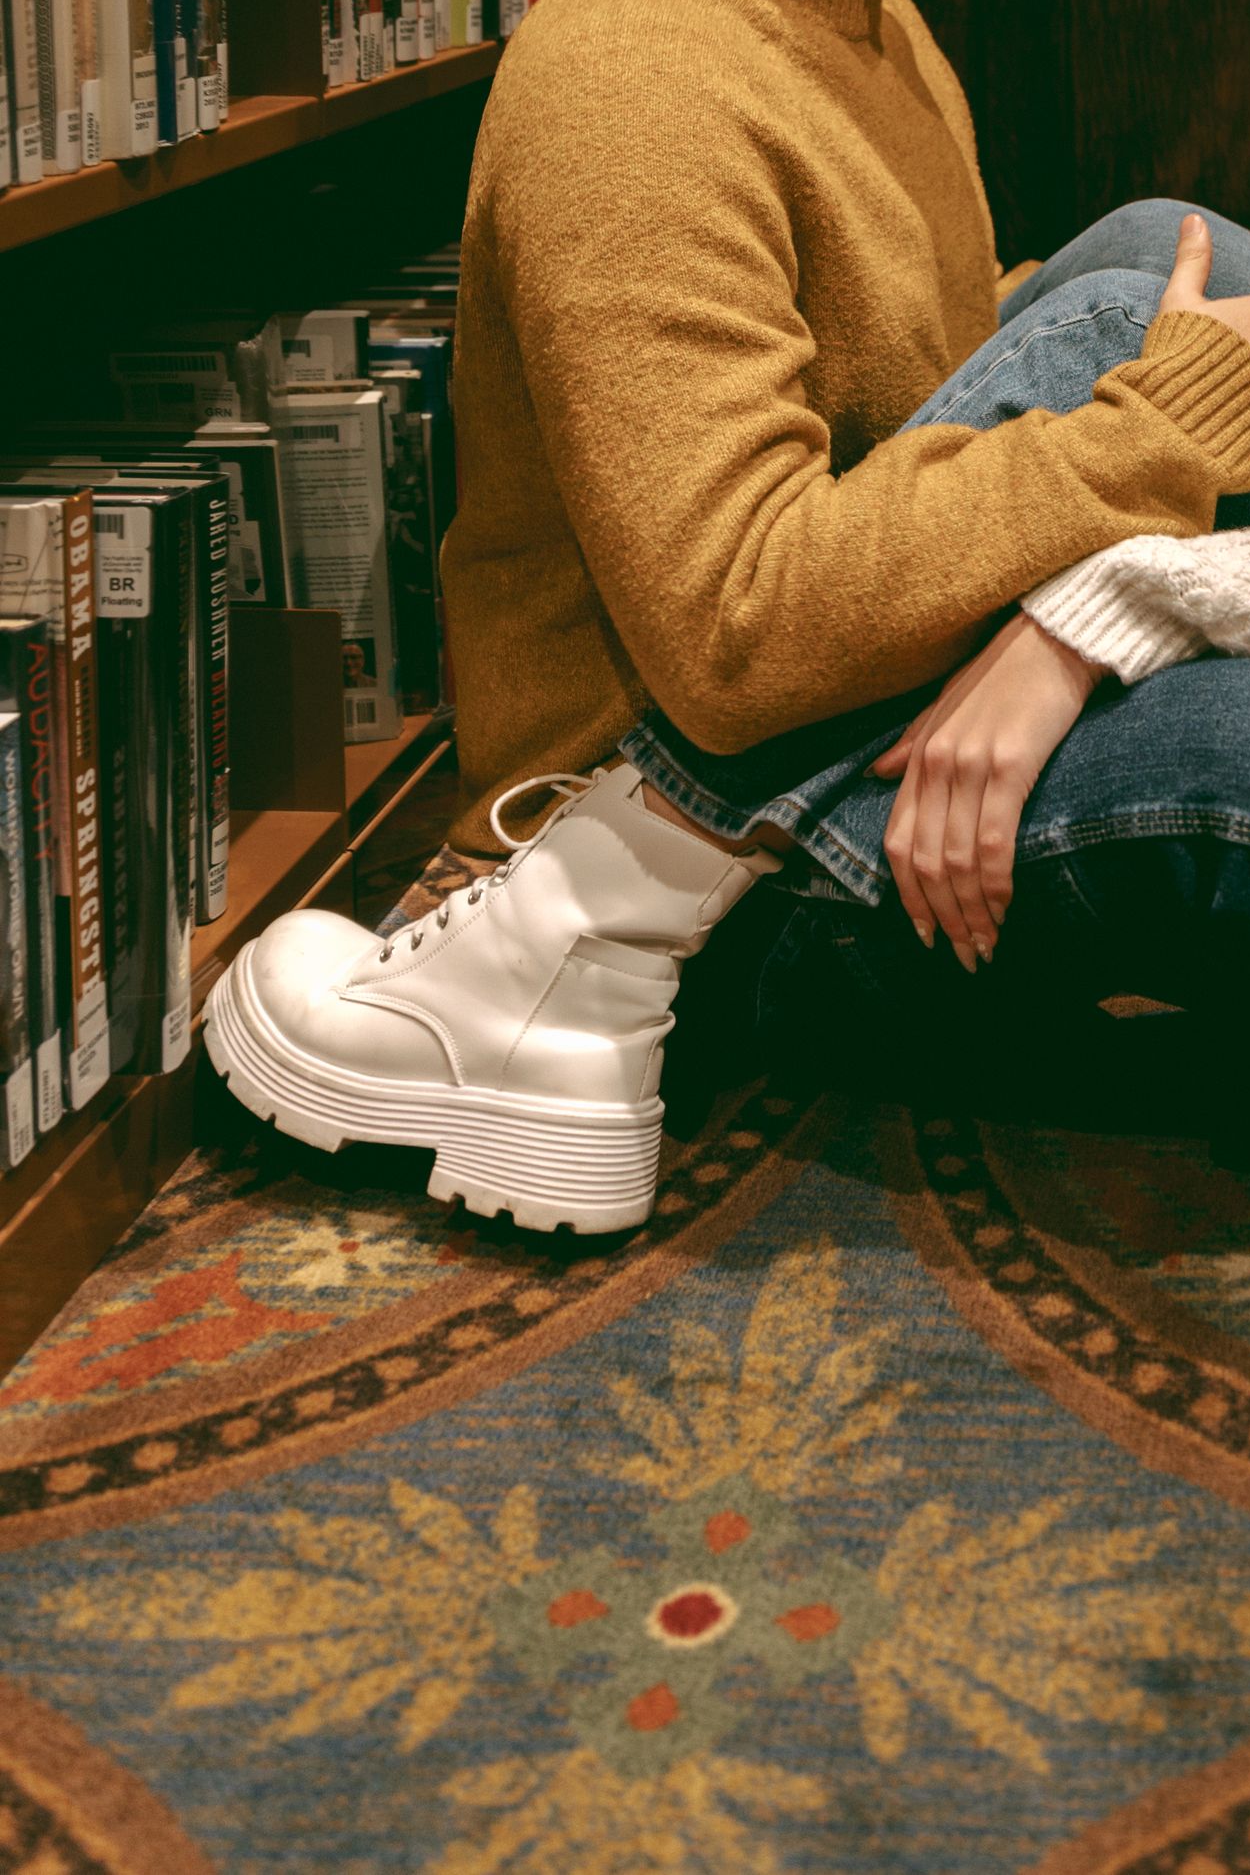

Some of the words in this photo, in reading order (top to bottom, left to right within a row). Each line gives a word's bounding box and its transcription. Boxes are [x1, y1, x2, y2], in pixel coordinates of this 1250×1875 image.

[205, 407, 233, 418] GRN
[209, 499, 227, 561] JARED
[69, 514, 92, 662] OBAMA
[101, 596, 144, 609] Floating
[109, 577, 136, 592] BR
[210, 567, 228, 662] KUSHNER
[27, 642, 51, 862] AUDACITY
[5, 749, 20, 853] WOMEN'S
[8, 855, 24, 947] STORIES
